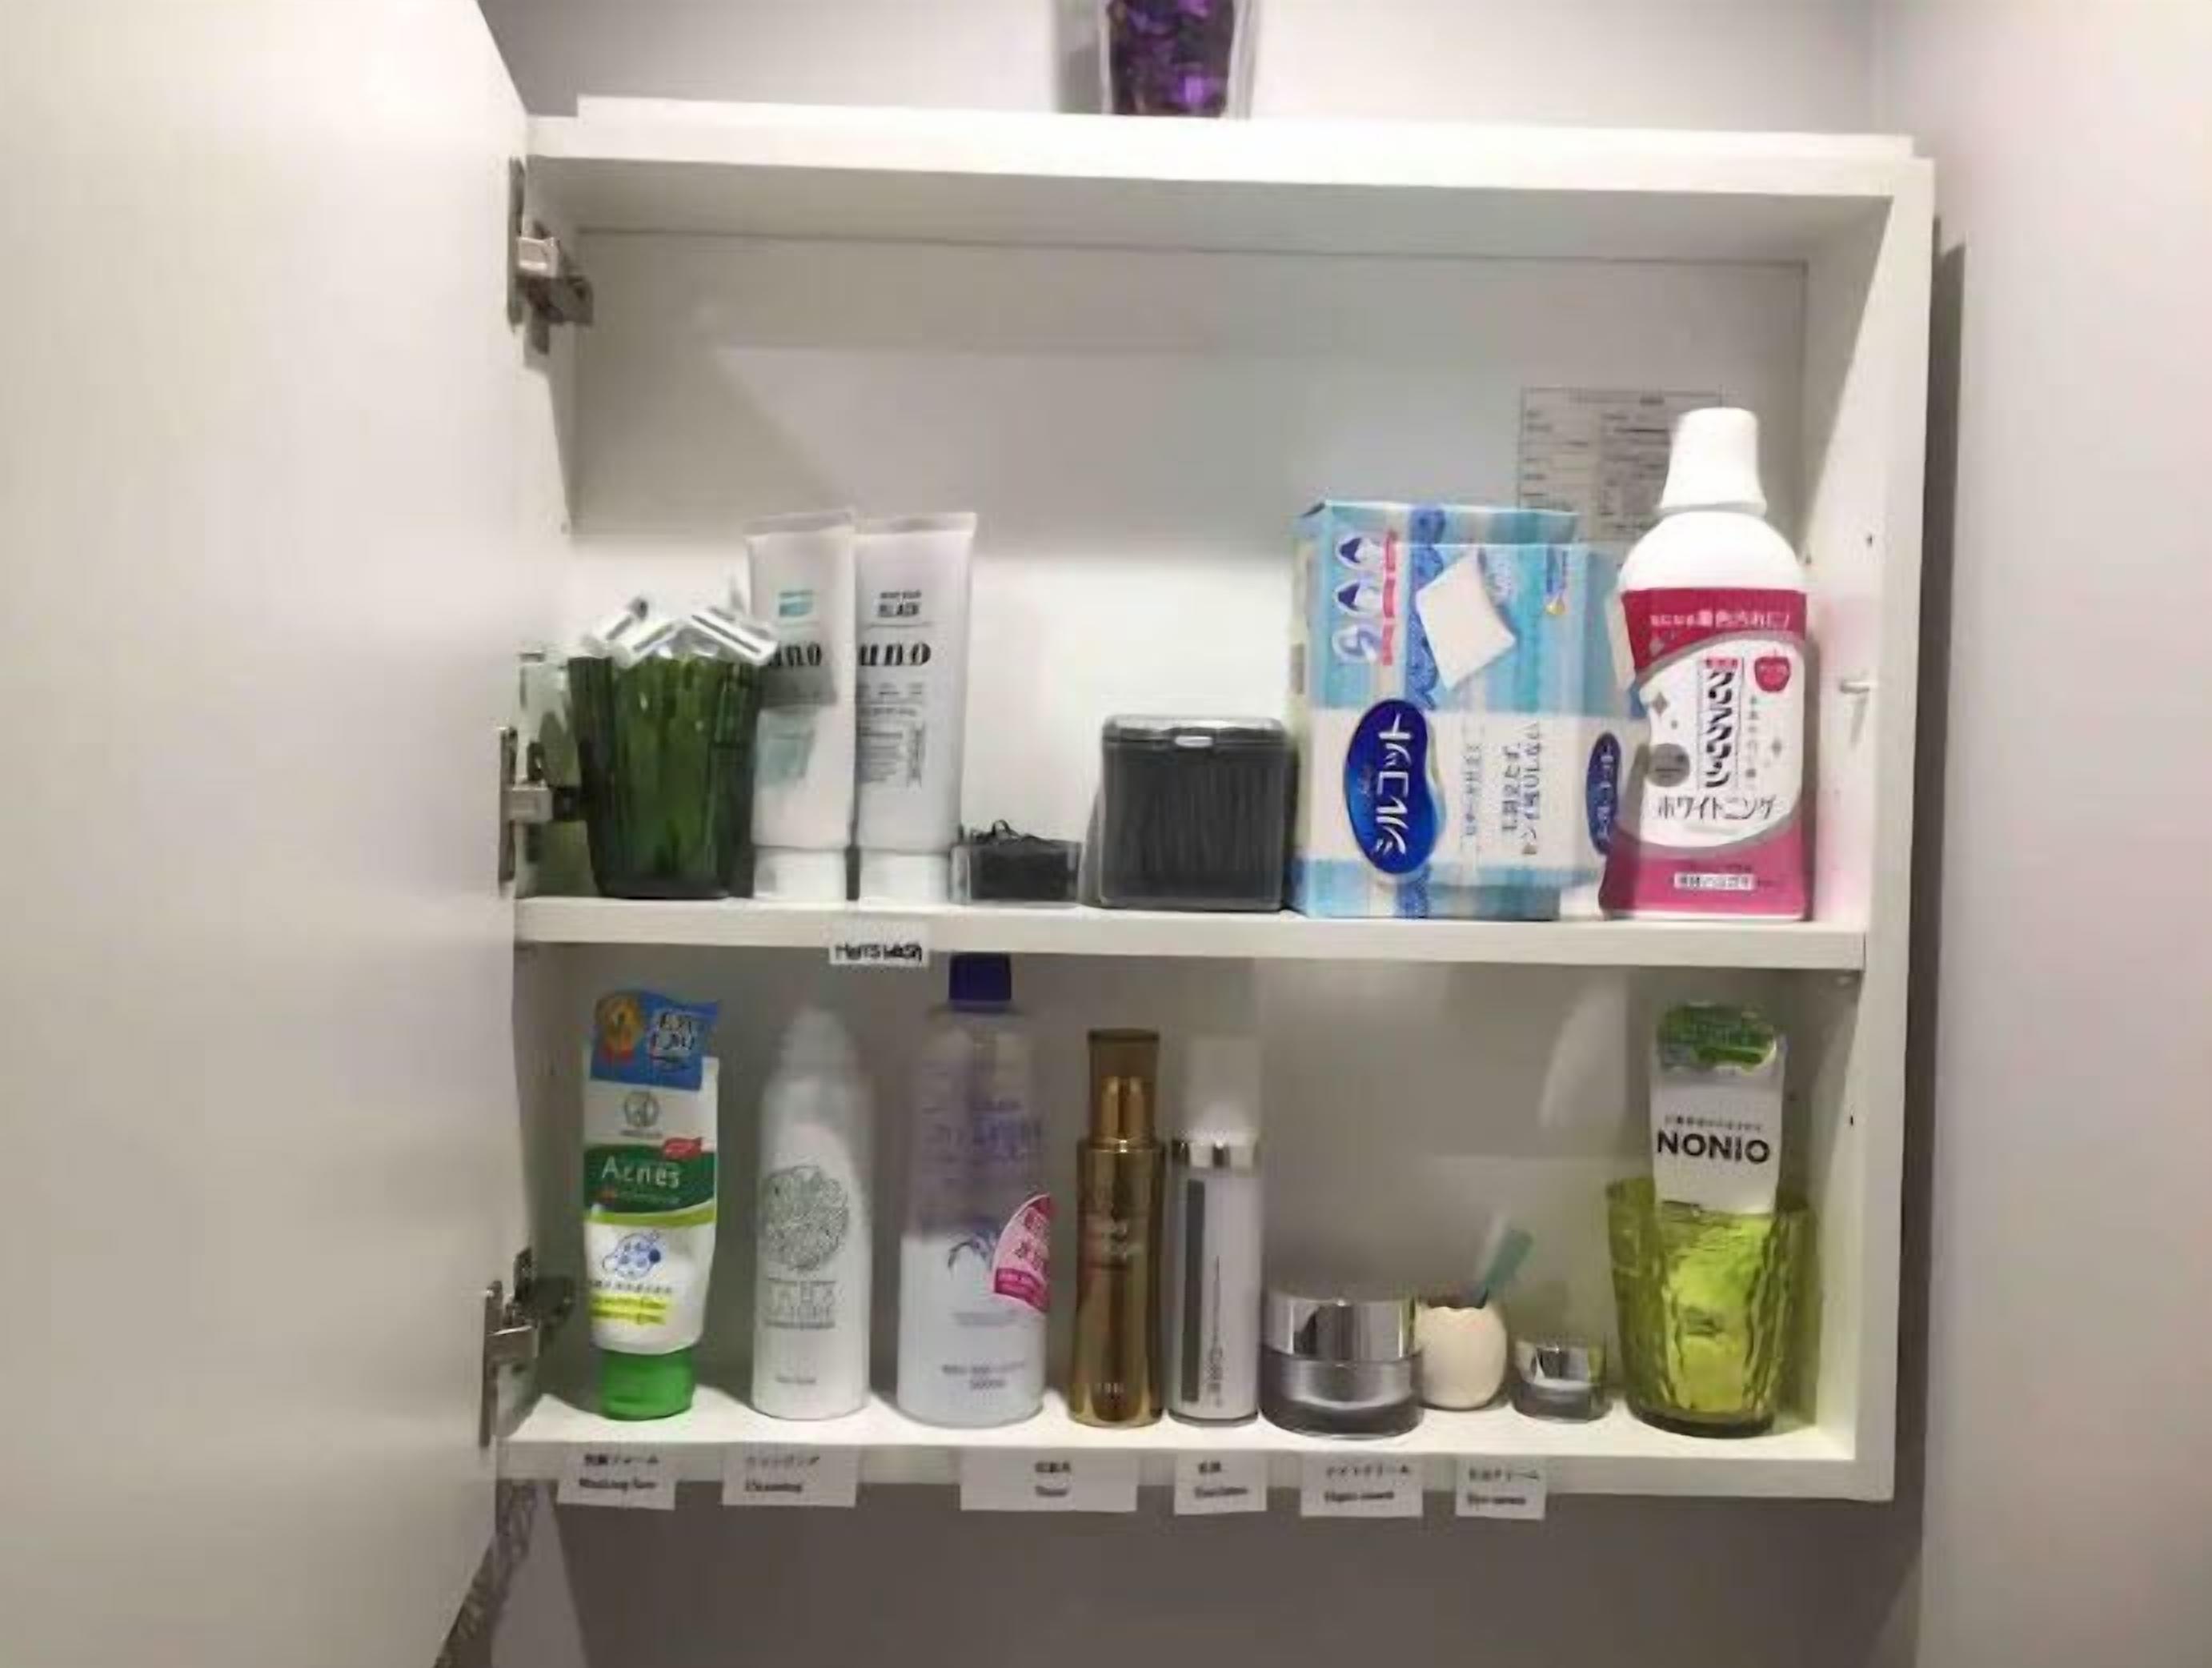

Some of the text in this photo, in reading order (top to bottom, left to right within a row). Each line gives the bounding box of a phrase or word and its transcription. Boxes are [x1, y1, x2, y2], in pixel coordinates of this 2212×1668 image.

[859, 642, 932, 667] uno
[1374, 712, 1414, 856] シルコット
[1657, 794, 1777, 828] ホワイトニング
[1657, 1129, 1770, 1165] NONIO
[601, 1155, 680, 1189] Acnes
